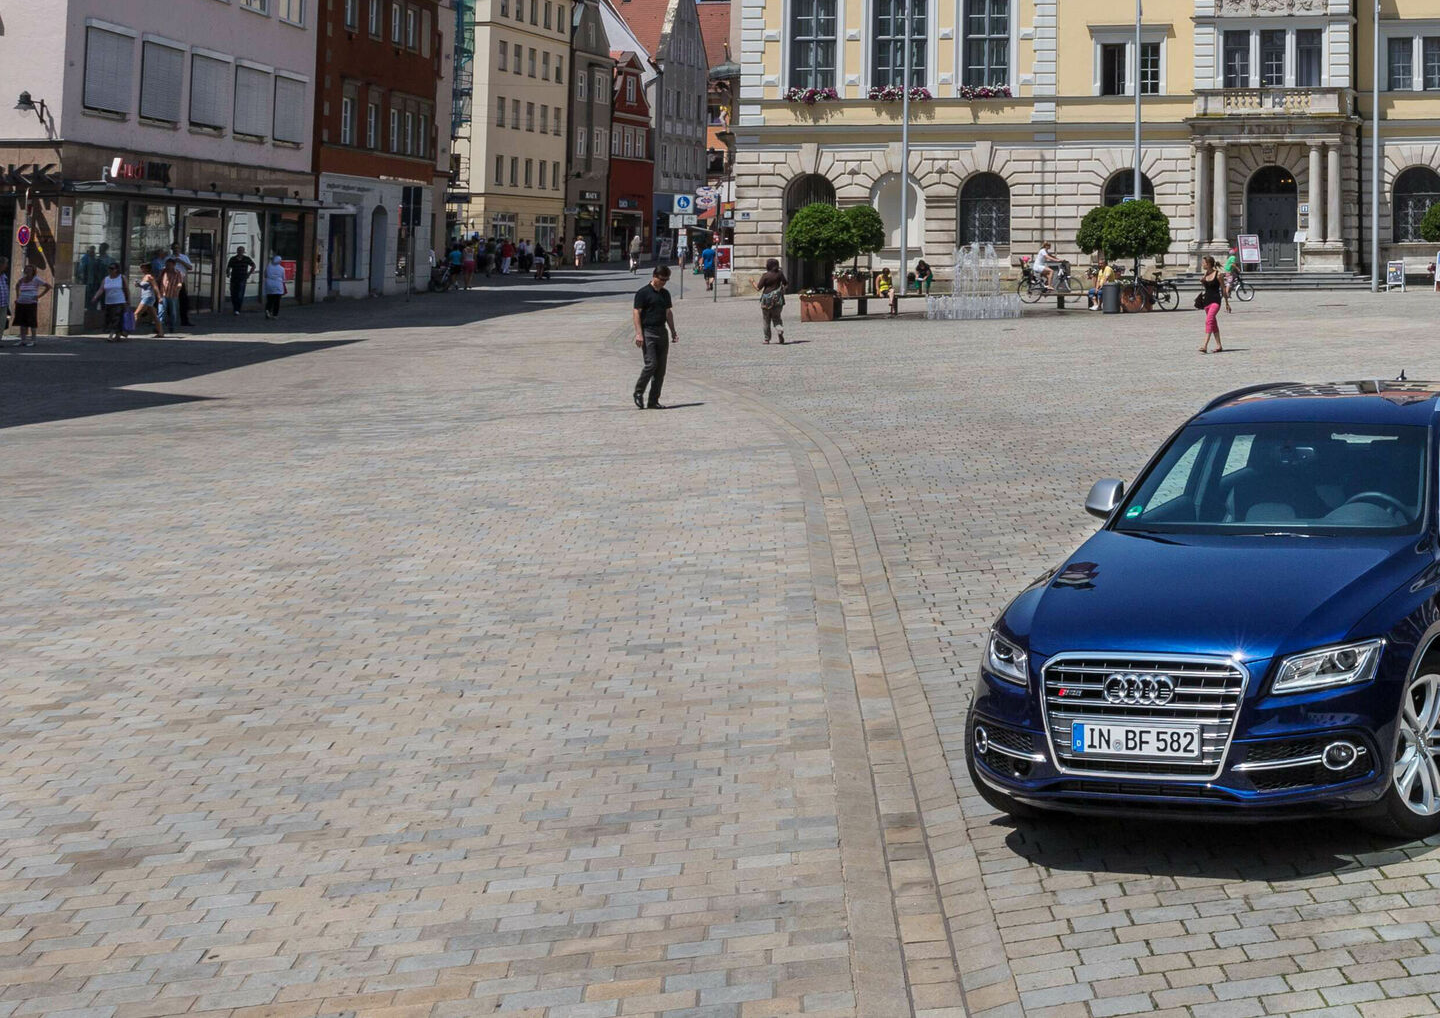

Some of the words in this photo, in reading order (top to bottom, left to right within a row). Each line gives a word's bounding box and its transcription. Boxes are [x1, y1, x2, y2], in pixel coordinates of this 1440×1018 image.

[1087, 728, 1111, 750] IN
[1125, 729, 1151, 751] BF
[1156, 731, 1195, 753] 582
